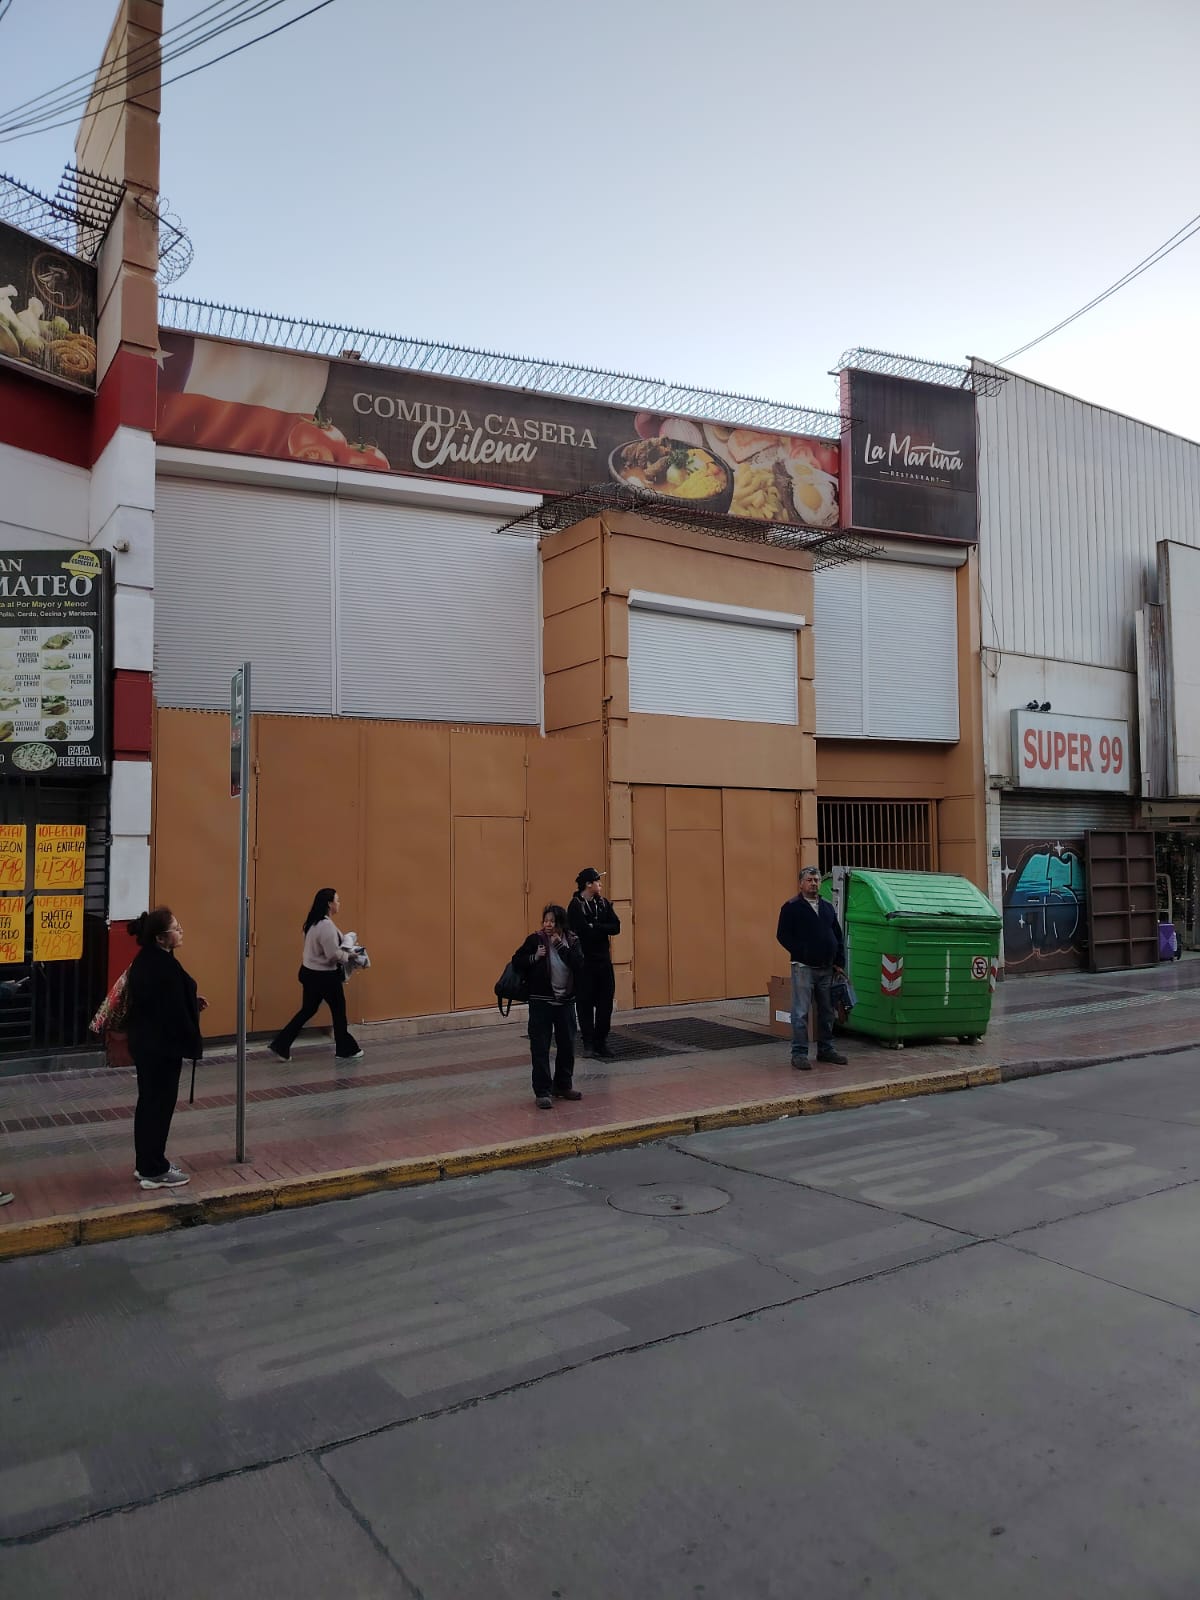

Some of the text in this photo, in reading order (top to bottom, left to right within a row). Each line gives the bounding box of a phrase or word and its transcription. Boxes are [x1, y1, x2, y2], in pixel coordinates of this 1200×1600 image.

[352, 392, 598, 449] COMIDA CASERA
[411, 421, 538, 469] Chilena
[864, 432, 964, 471] La Martina
[31, 601, 55, 609] Mayor
[67, 745, 91, 755] PAPA
[76, 756, 101, 767] FRITA
[1023, 728, 1123, 774] SUPER 99
[0, 929, 20, 940] RDO
